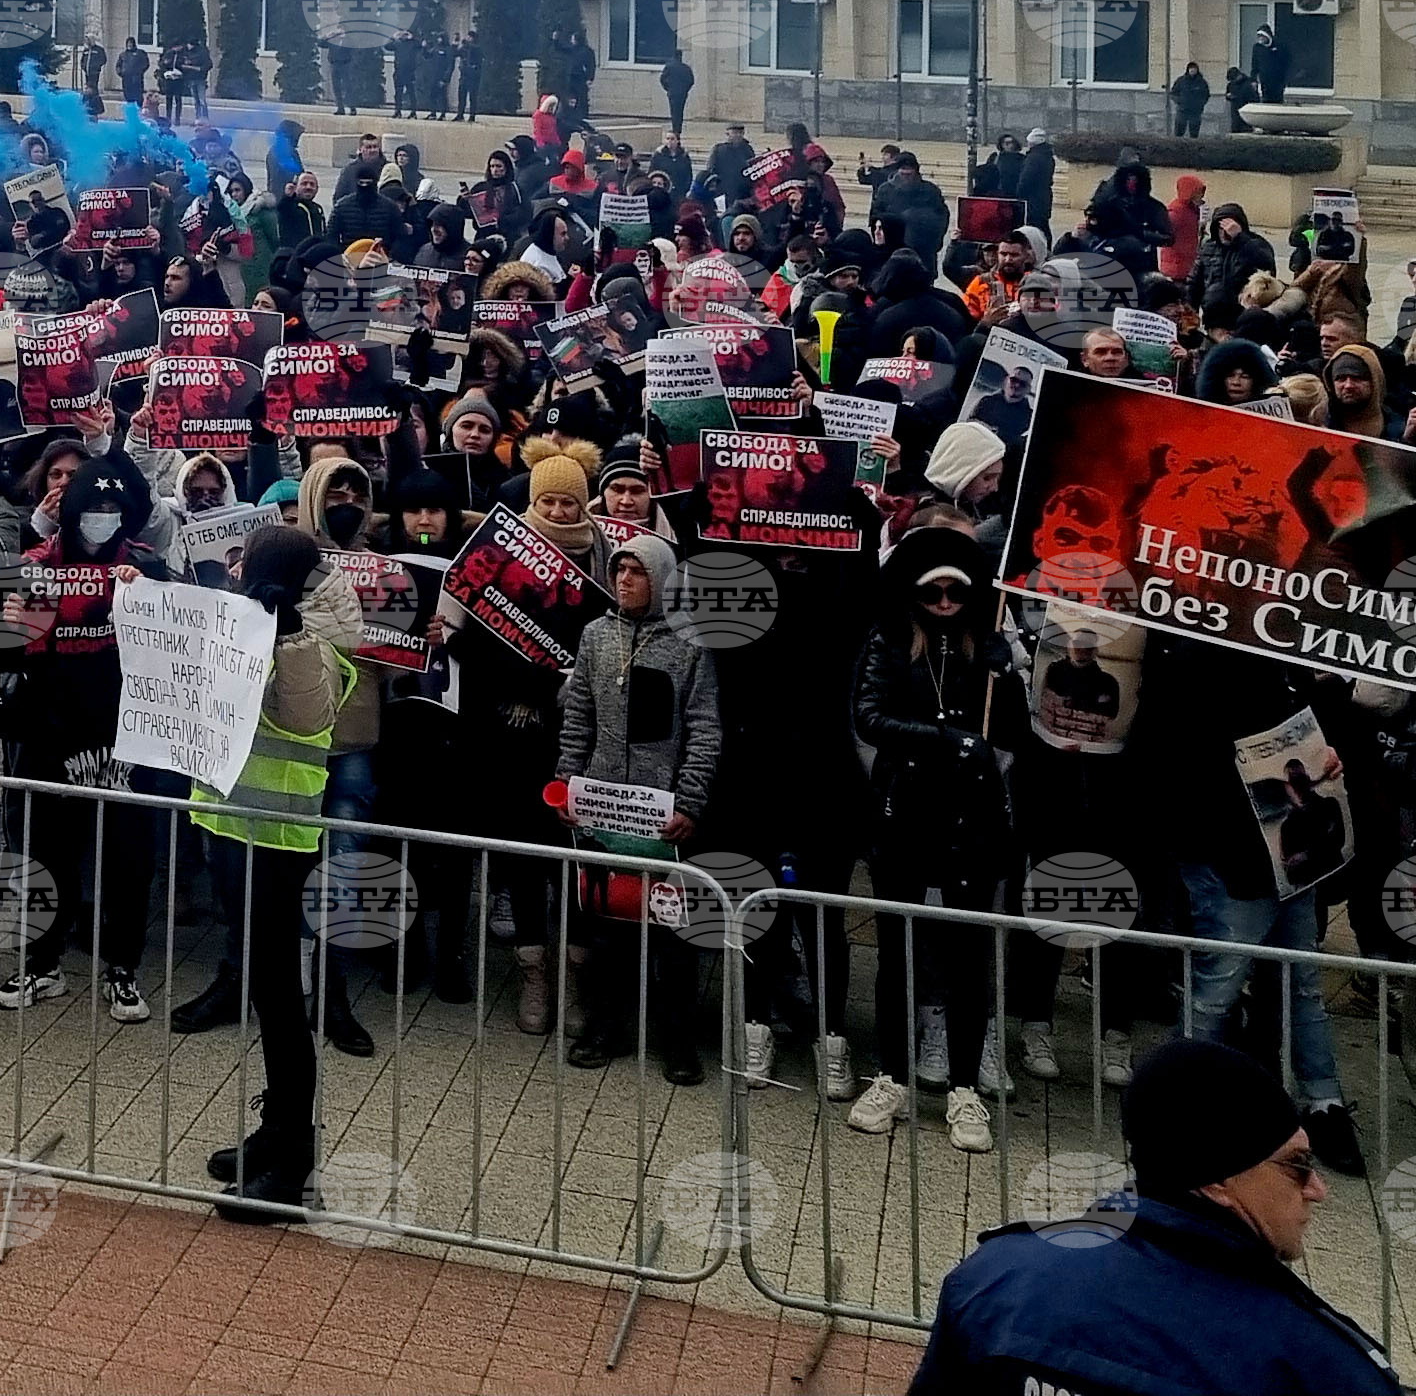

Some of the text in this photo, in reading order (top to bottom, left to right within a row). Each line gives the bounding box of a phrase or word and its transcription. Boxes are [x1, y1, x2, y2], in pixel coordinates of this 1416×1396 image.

[778, 150, 791, 158] ЗА
[750, 159, 784, 181] СИМО!
[116, 190, 128, 199] ЗА
[80, 200, 116, 210] СИМО!
[691, 268, 738, 288] СИМО!
[473, 303, 533, 312] СВОБОДА ЗА
[478, 311, 521, 321] СИМО!
[163, 311, 250, 324] СВОБОДА ЗА
[170, 323, 230, 337] СИМО!
[740, 329, 760, 340] ЗА
[18, 334, 77, 351] СВОБОДА
[337, 344, 359, 356] ЗА
[22, 348, 81, 367] СИМО!
[865, 358, 930, 371] СВОБОДА ЗА
[153, 360, 239, 373] СВОБОДА ЗА
[266, 358, 336, 376] СИМО!
[866, 367, 912, 379] СИМО!
[158, 372, 220, 386] СИМО!
[294, 420, 400, 437] МОМЧИЛ!
[151, 435, 176, 449] ЗА
[705, 433, 819, 454] СВОБОДА ЗА
[715, 450, 792, 472] СИМО!
[188, 521, 243, 546] С ТЕБ СМЕ,
[702, 523, 858, 549] ЗА МОМЧИЛ!
[493, 529, 558, 587] СИМО!
[494, 511, 563, 573] СВОБОДА
[563, 568, 584, 592] ЗА
[20, 565, 103, 580] СВОБОДА
[383, 559, 404, 576] ЗА
[1134, 523, 1416, 626] НепоноСим
[30, 581, 104, 597] СИМО!
[445, 574, 472, 604] ЗА
[1140, 576, 1230, 632] без
[216, 600, 229, 637] НЕ
[484, 585, 575, 666] СПРАВЕДЛИВОСТ
[208, 640, 246, 676] ГЛАСЪТ
[246, 654, 265, 685] НА
[182, 687, 201, 713] ЗА
[584, 783, 656, 802] СВОБОДА ЗА
